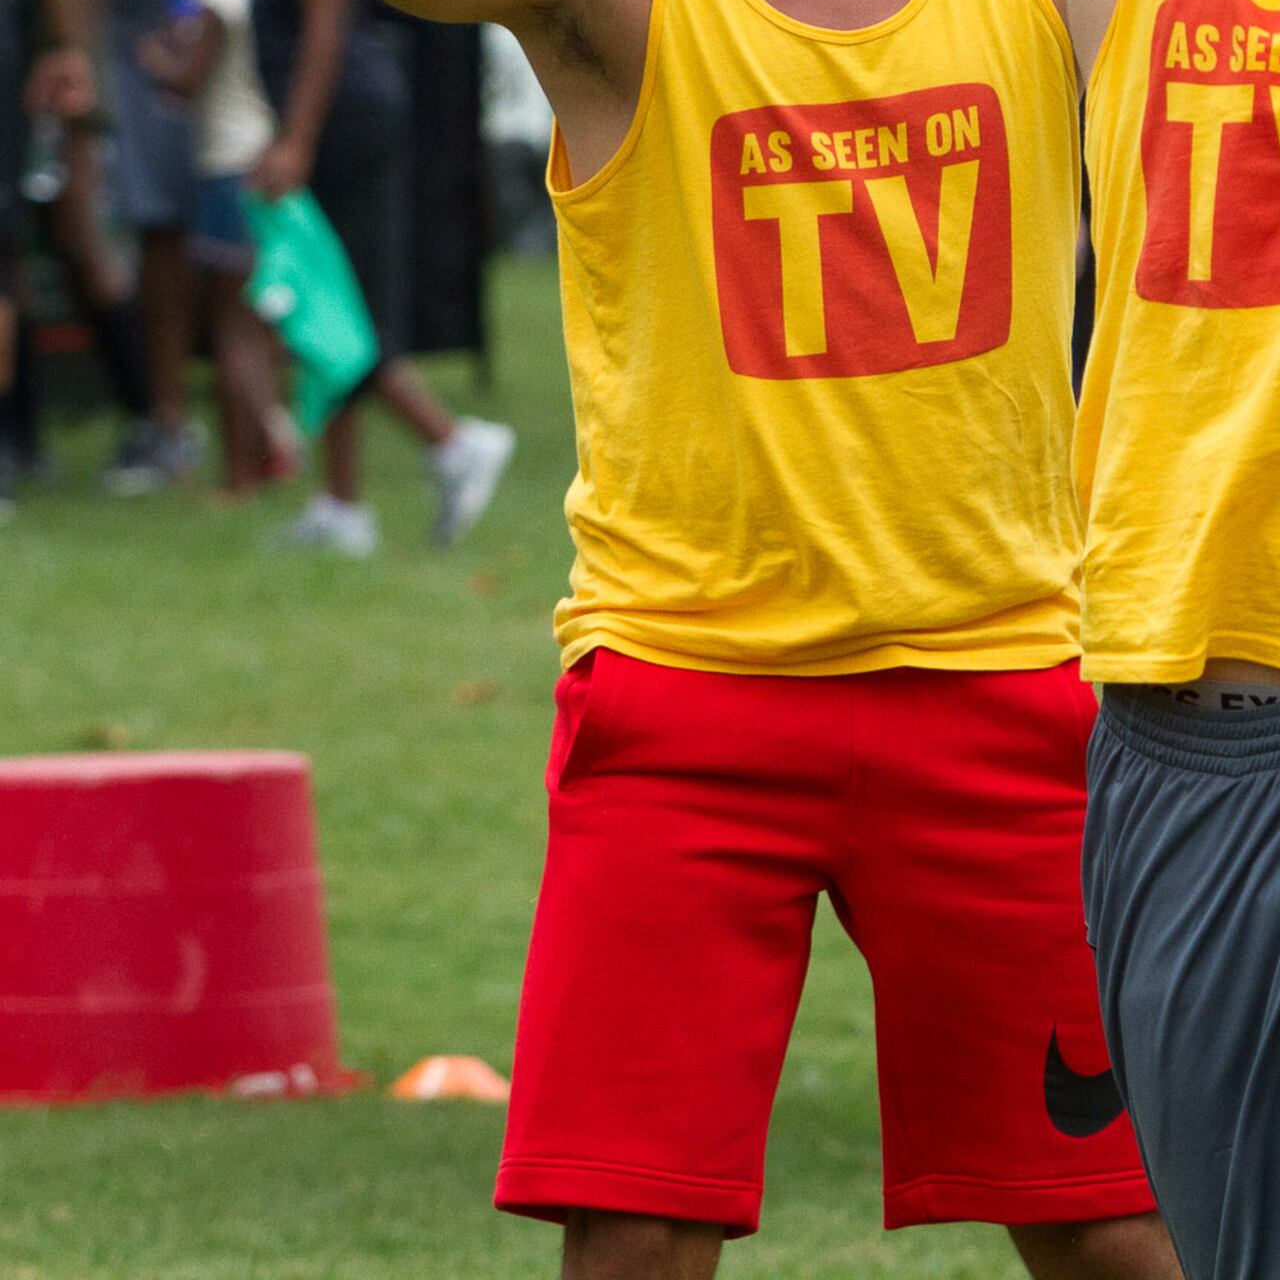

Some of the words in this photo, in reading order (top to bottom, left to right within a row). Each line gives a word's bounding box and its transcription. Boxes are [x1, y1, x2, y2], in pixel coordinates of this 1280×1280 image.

[1164, 21, 1220, 72] AS
[740, 130, 793, 175] AS
[811, 122, 909, 171] SEEN
[926, 105, 981, 157] ON
[742, 159, 980, 358] TV
